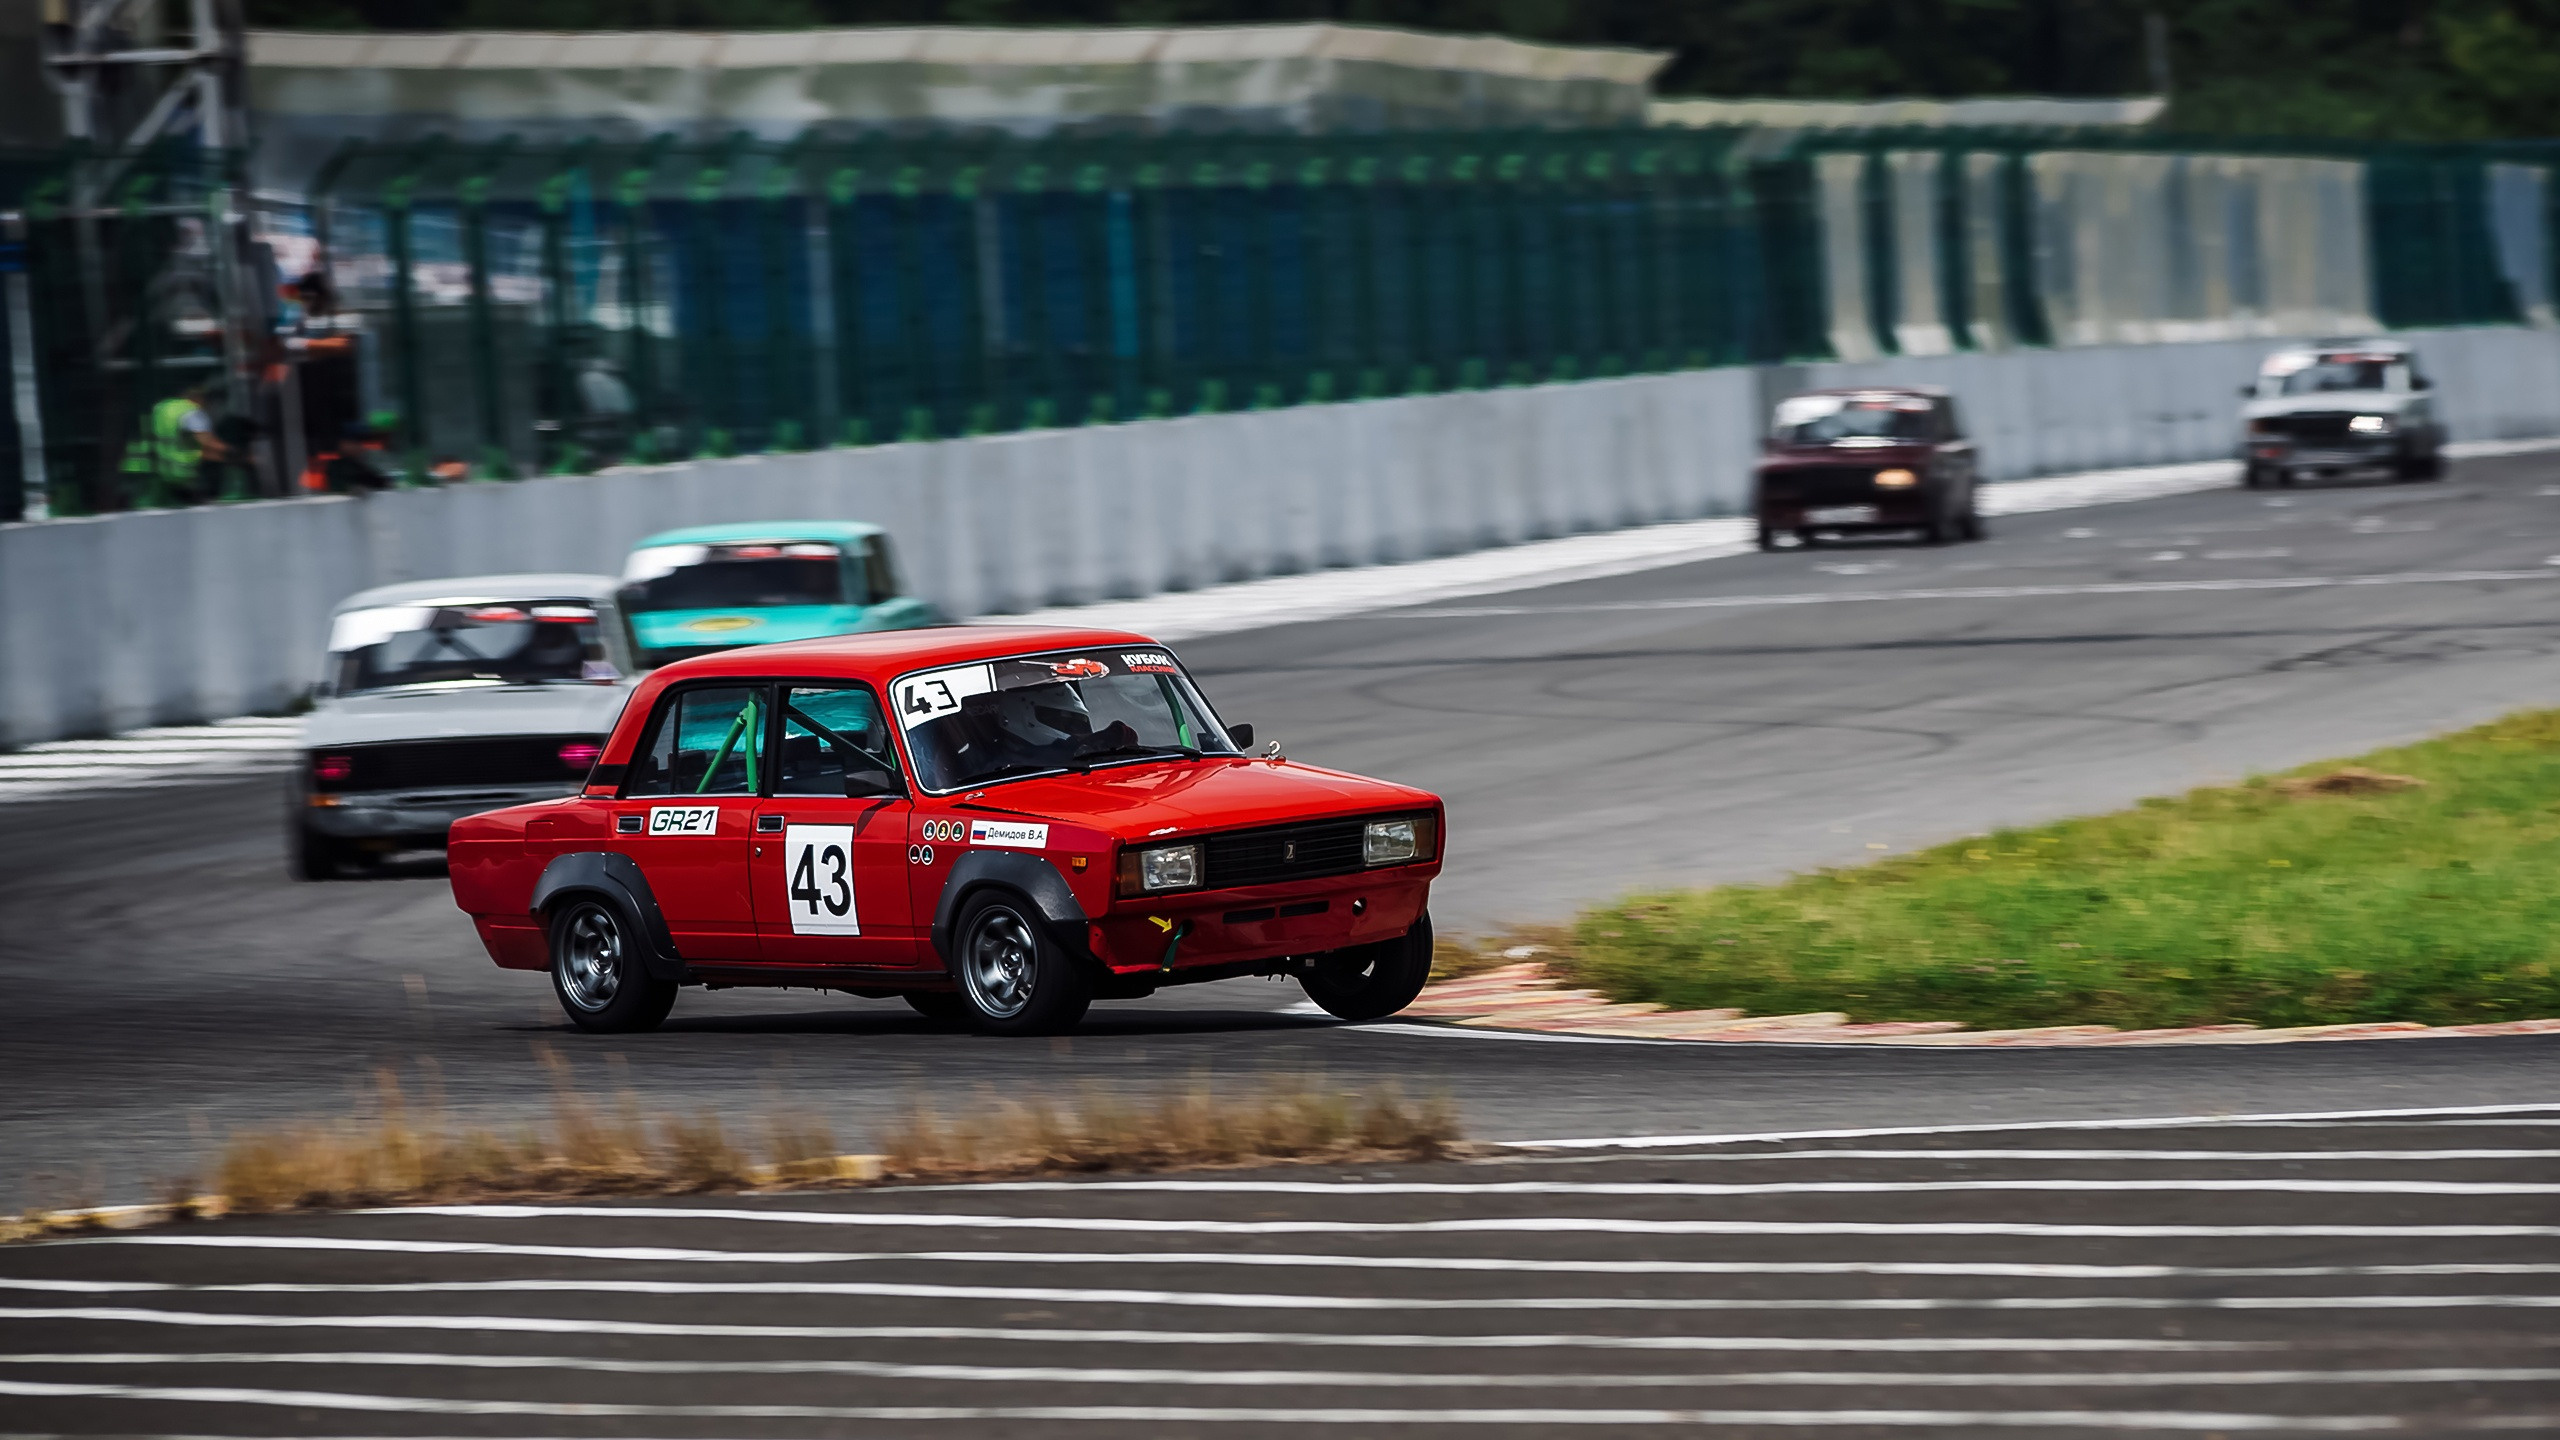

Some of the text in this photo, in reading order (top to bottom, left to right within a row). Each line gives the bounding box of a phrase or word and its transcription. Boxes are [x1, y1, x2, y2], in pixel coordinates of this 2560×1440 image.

[1120, 653, 1172, 666] КУБОК
[904, 680, 958, 715] 43
[652, 810, 715, 831] GR21
[987, 827, 1026, 840] Демидов
[791, 844, 851, 917] 43
